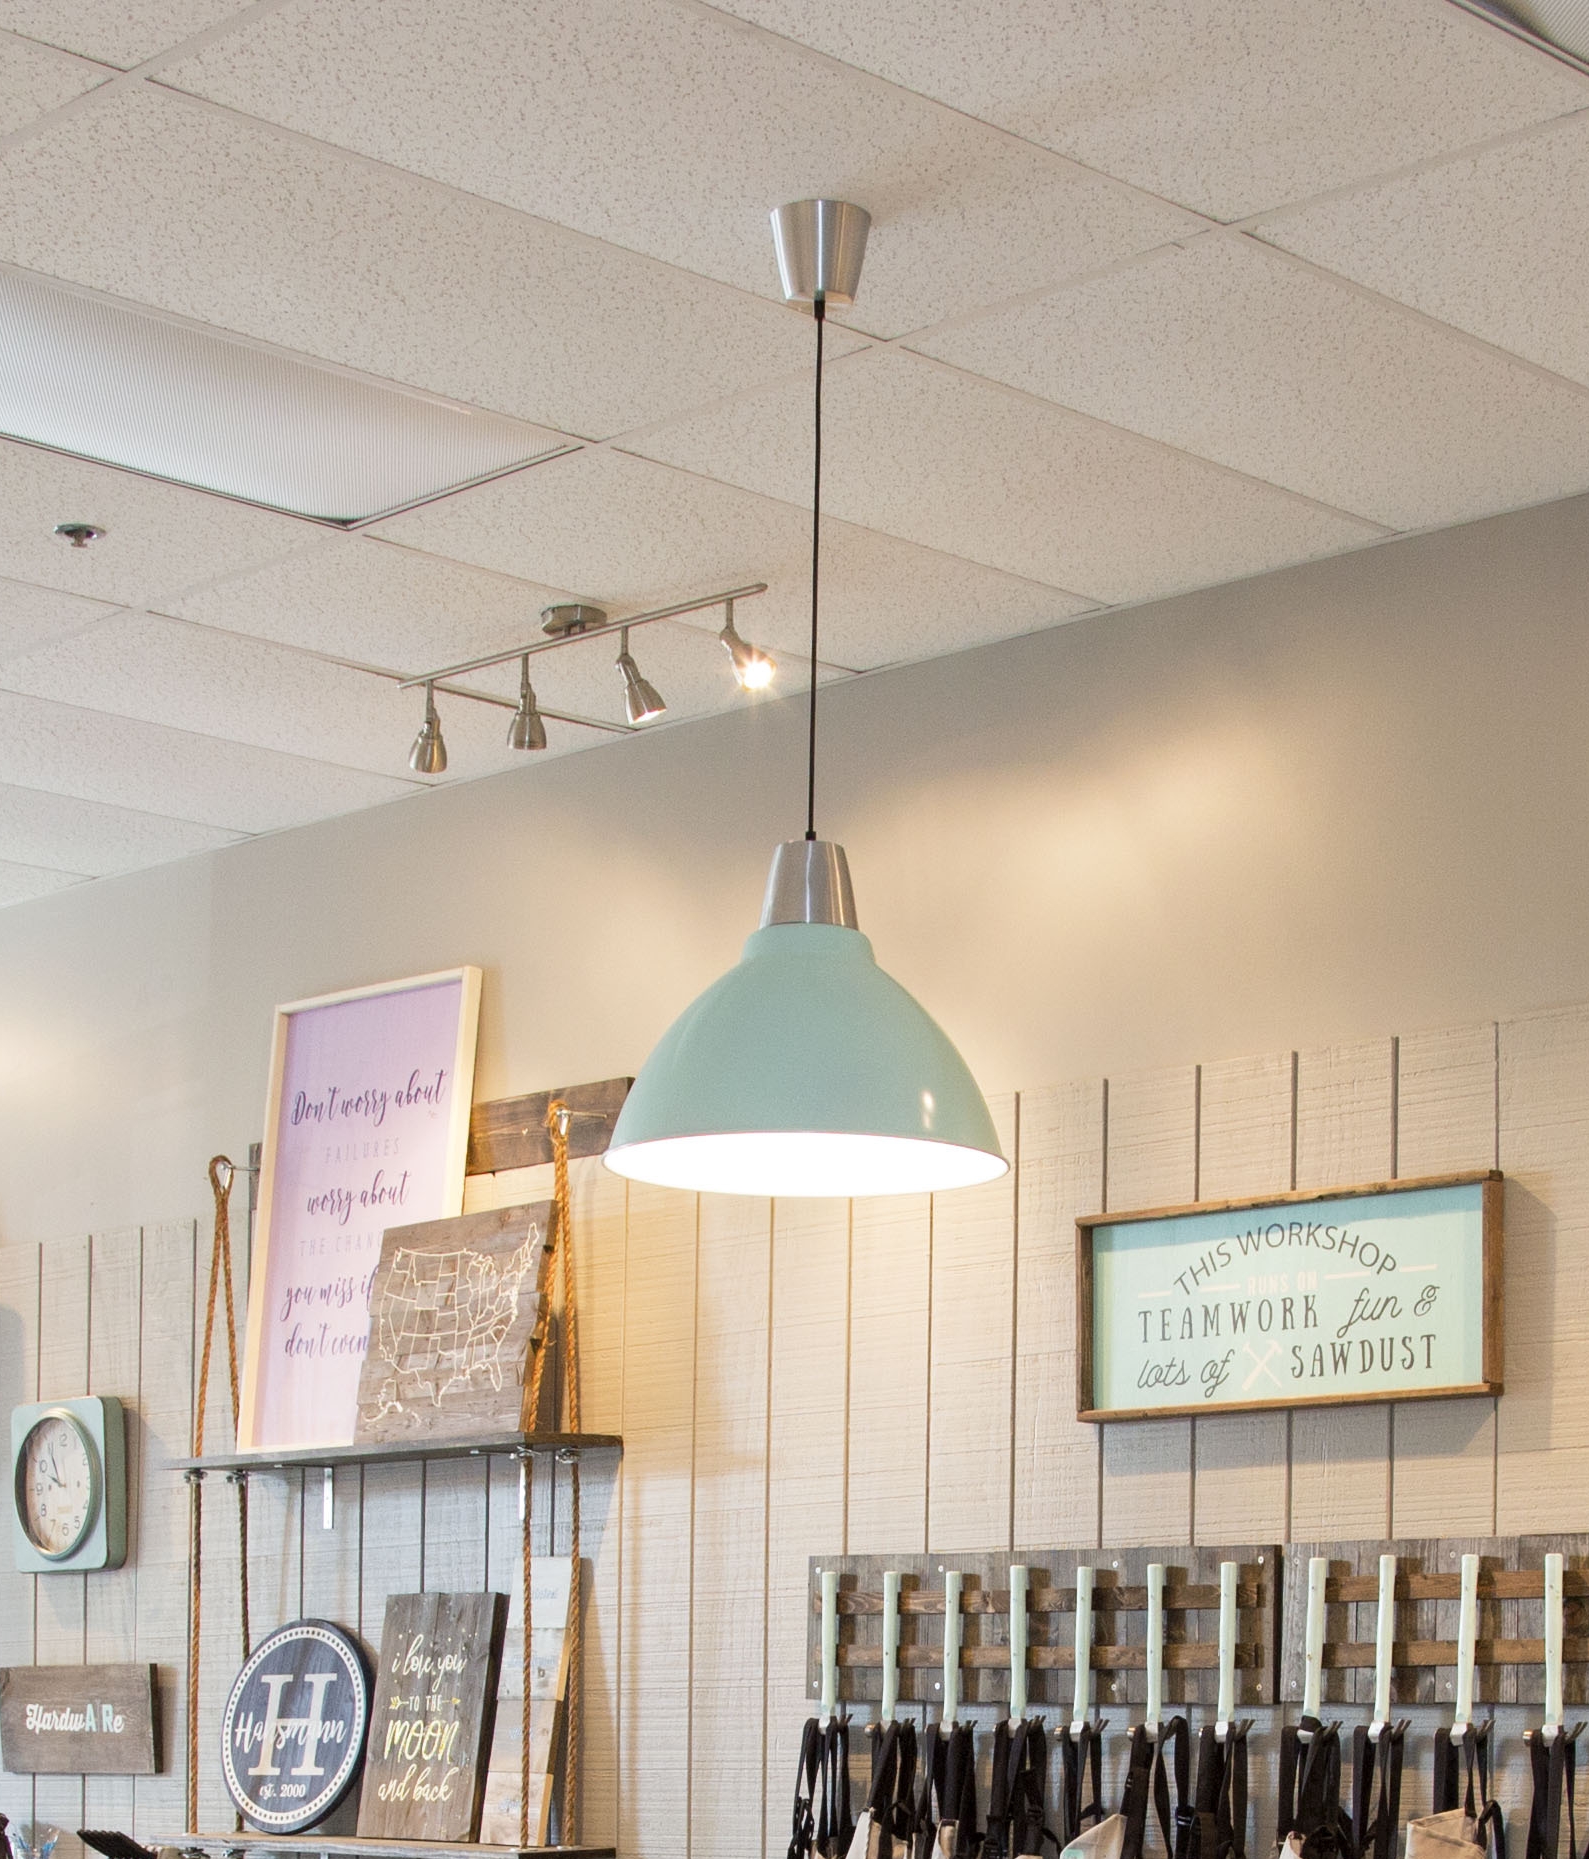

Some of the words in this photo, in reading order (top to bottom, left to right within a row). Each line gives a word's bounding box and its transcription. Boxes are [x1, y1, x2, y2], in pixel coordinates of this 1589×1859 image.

[340, 1088, 392, 1127] worry
[394, 1067, 448, 1107] about
[324, 1138, 400, 1165] FAILURES
[306, 1186, 356, 1226] worry
[359, 1169, 411, 1208] about
[300, 1238, 327, 1258] THE
[1173, 1241, 1232, 1296] THIS
[1236, 1221, 1397, 1276] WORKSHOP
[280, 1285, 315, 1321] you
[1247, 1273, 1290, 1297] RUNS
[1297, 1270, 1318, 1292] ON
[1137, 1293, 1319, 1344] TEAMWORK
[1337, 1286, 1403, 1338] fun
[1137, 1355, 1191, 1390] lots
[1200, 1348, 1236, 1398] of
[1291, 1333, 1437, 1379] SAWDUST
[403, 1633, 433, 1675] love
[434, 1655, 468, 1692] you
[248, 1673, 338, 1777] H
[408, 1697, 420, 1712] TO
[425, 1694, 442, 1711] THE
[279, 1783, 307, 1798] 2000
[377, 1765, 411, 1802] and
[413, 1766, 455, 1802] back
